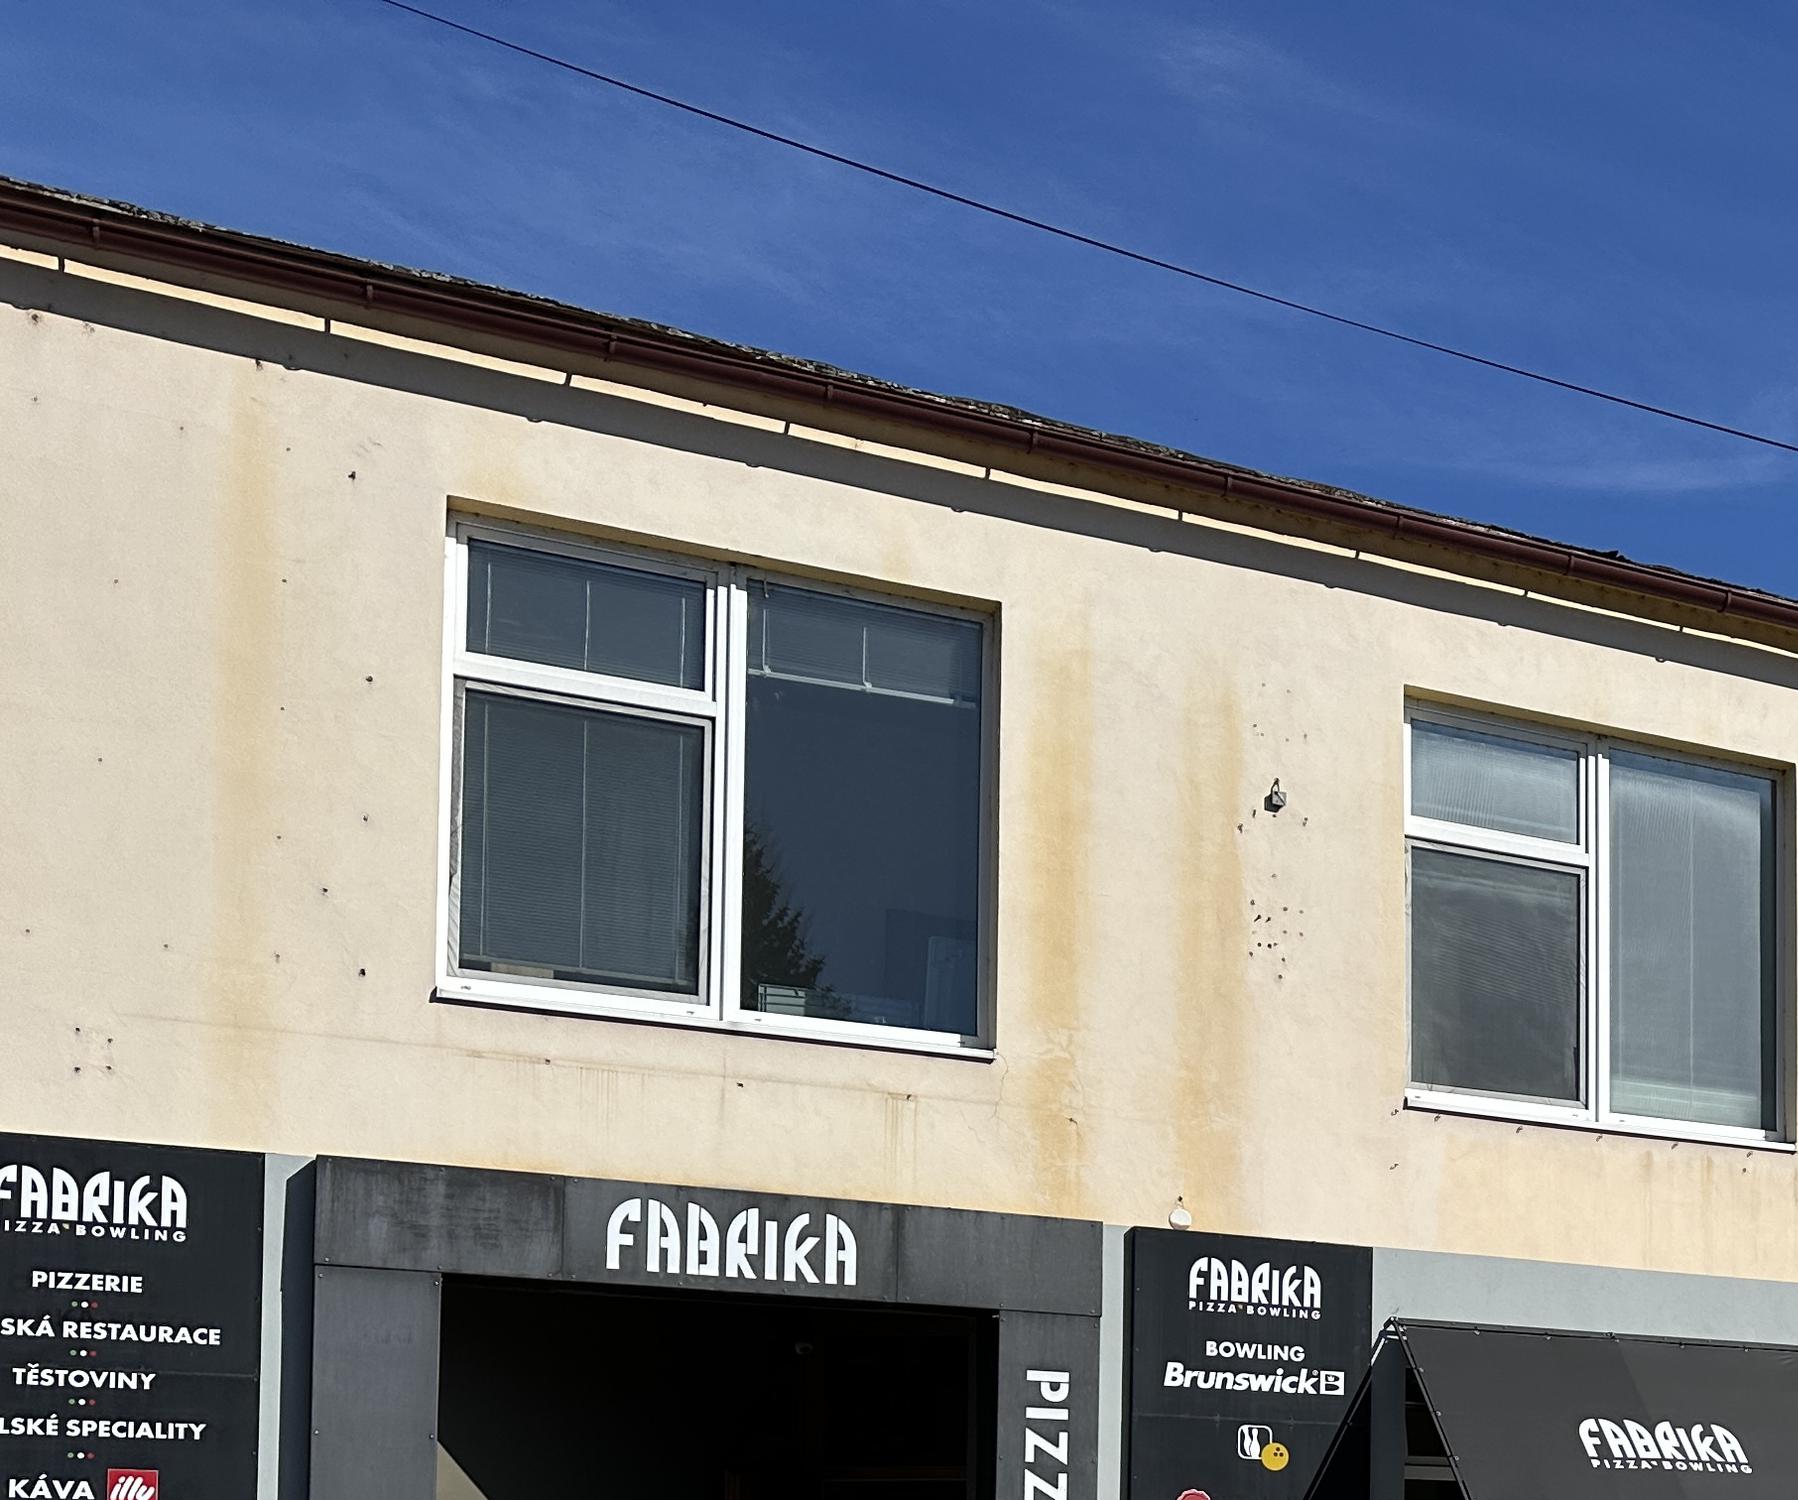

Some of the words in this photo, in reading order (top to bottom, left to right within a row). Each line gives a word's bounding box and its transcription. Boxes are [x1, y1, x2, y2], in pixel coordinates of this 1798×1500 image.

[0, 1164, 188, 1229] FABRIKA
[0, 1220, 60, 1235] IZZA
[76, 1224, 187, 1242] BOWLING
[606, 1198, 857, 1286] FABRIKA
[32, 1270, 143, 1293] PIZZERIE
[1188, 1256, 1321, 1308] FABRIKA
[0, 1314, 55, 1337] SKÁ
[62, 1320, 221, 1346] RESTAURACE
[1205, 1340, 1305, 1362] BOWLING
[12, 1362, 156, 1390] TĚSTOVINY
[0, 1413, 59, 1436] LSKÉ
[66, 1419, 207, 1441] SPECIALITY
[1578, 1418, 1749, 1464] FABRIKA
[8, 1474, 95, 1499] KÁVA
